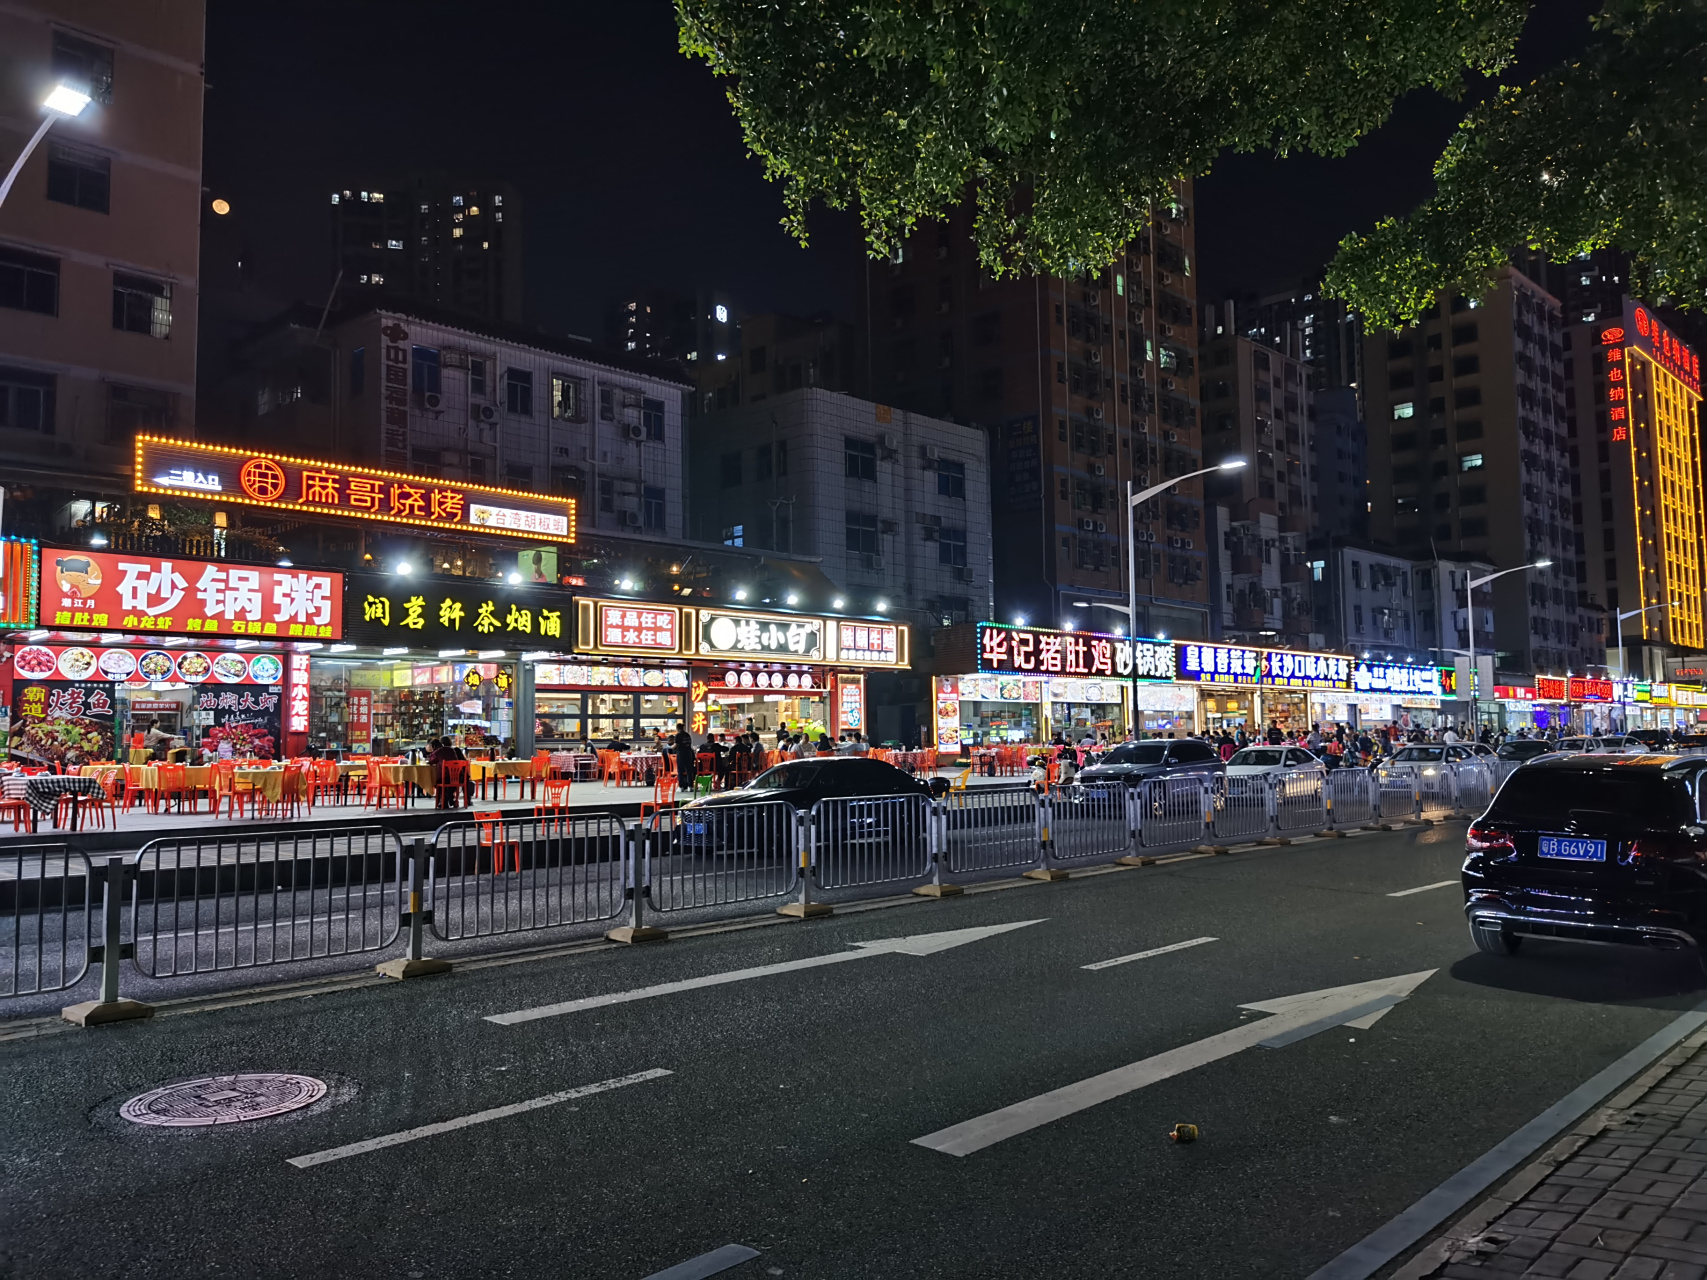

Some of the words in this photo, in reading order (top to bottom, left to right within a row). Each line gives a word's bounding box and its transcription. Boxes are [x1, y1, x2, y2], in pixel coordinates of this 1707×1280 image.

[1607, 347, 1627, 441] 维也纳酒店
[168, 468, 220, 487] 二楼入口
[298, 470, 465, 523] 麻哥烧烤
[116, 561, 331, 626] 砂锅粥
[55, 611, 108, 627] 猪肚鸡
[123, 615, 172, 629] 小龙虾
[187, 618, 219, 632] 烤鱼
[231, 620, 278, 634] 石锅鱼
[289, 625, 333, 638] 跳跳蛙
[363, 594, 561, 639] 润茗轩茶烟酒
[606, 609, 673, 629] 菜品任吃
[606, 628, 673, 646] 酒水任喝
[736, 620, 807, 654] 蛙小白
[1186, 645, 1257, 676] 皇朝香辣虾
[1270, 653, 1349, 681] 长沙口味小龙虾
[468, 672, 480, 686] 烟
[22, 687, 46, 718] 霸道
[49, 688, 112, 716] 烤鱼
[200, 691, 278, 712] 油焖大虾
